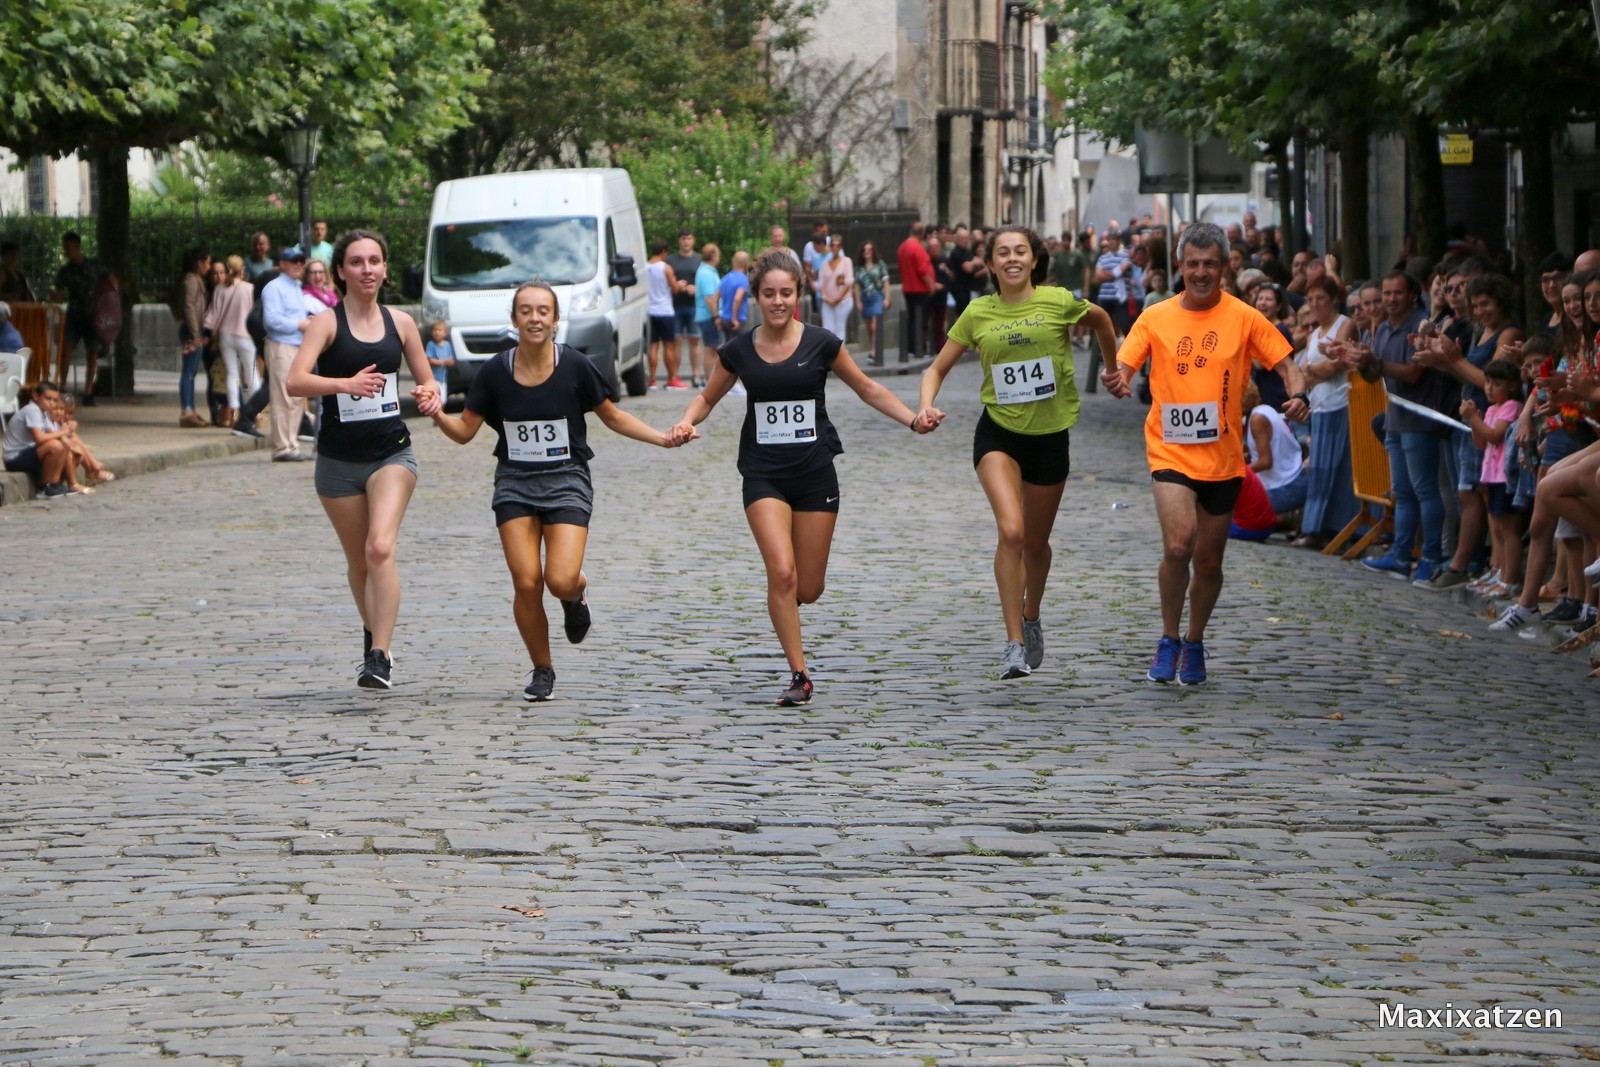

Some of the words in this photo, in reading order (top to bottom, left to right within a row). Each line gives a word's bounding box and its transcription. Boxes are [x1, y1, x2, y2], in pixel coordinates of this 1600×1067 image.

[1003, 362, 1044, 385] 814
[766, 404, 805, 424] 818
[1170, 407, 1208, 427] 804
[517, 424, 556, 443] 813
